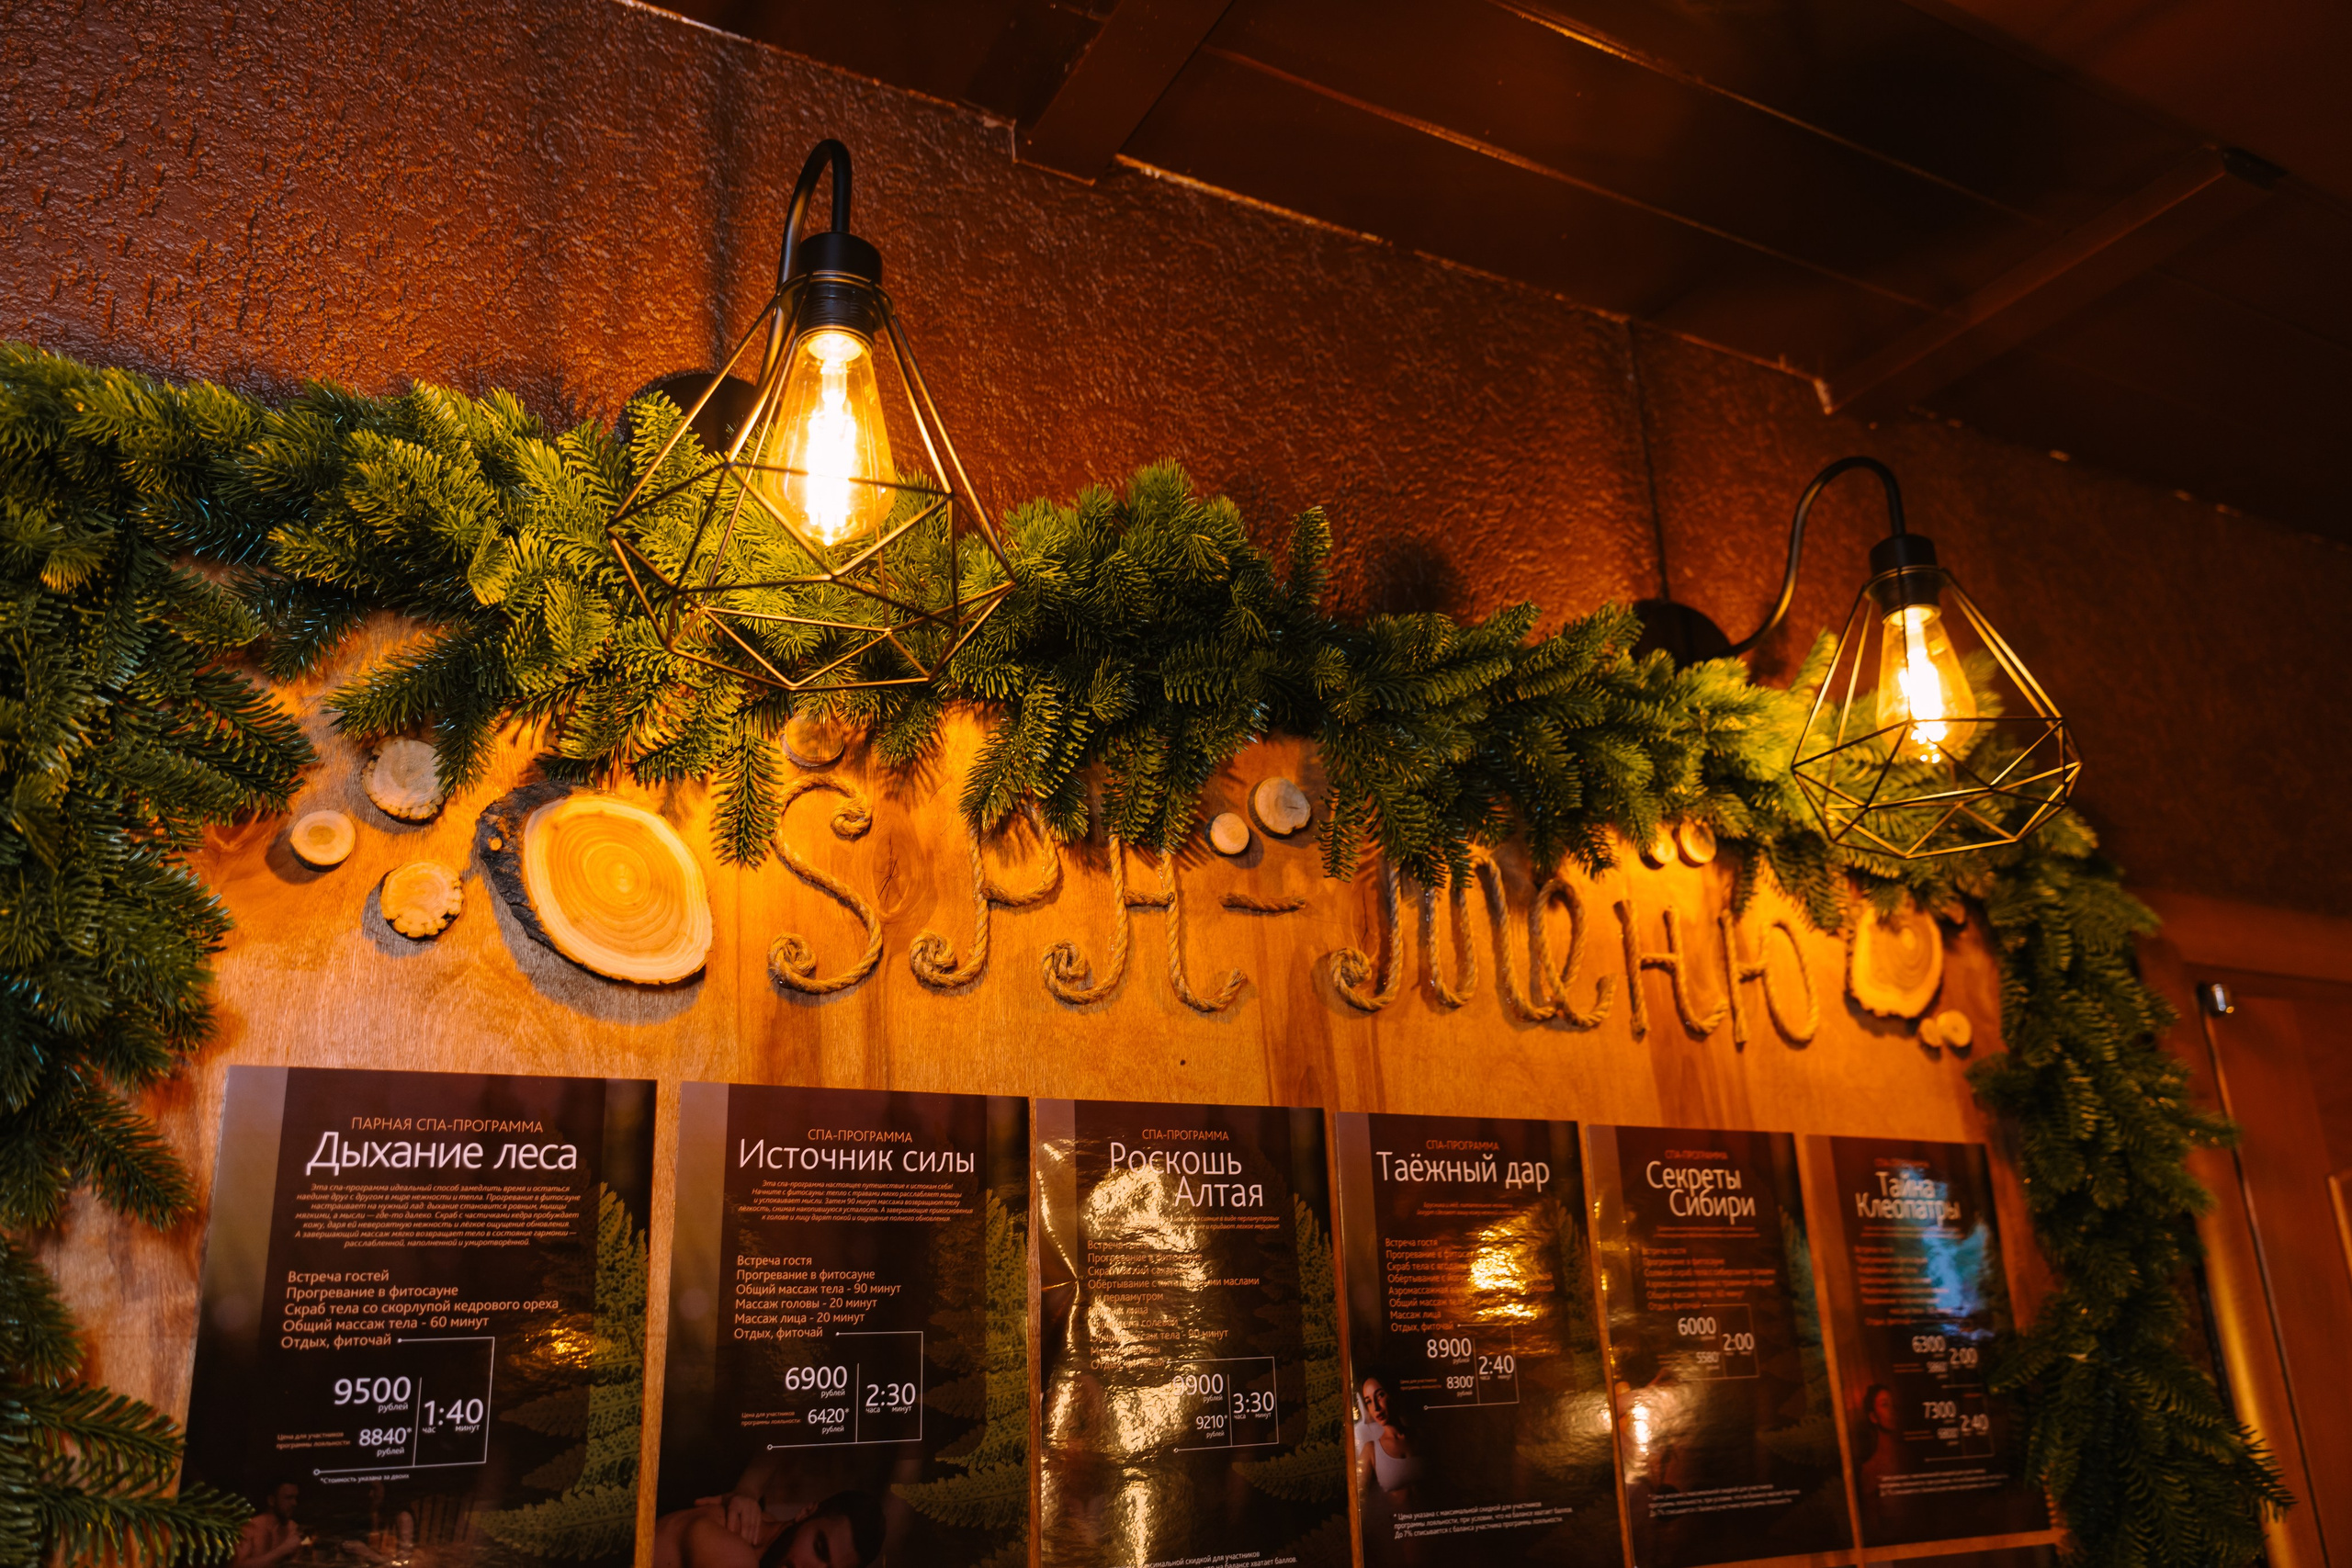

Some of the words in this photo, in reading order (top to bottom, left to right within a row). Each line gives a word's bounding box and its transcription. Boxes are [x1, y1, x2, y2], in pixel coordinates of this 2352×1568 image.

[352, 1117, 413, 1130] ПАРНАЯ
[416, 1118, 544, 1133] СПА-ПРОГРАММА
[808, 1128, 913, 1143] СПА-ПРОГРАММА
[1142, 1128, 1229, 1141] СПА-ПРОГРАММА
[1426, 1140, 1499, 1151] СПА-ПРОГРАММА
[306, 1131, 484, 1177] Дыхание
[492, 1143, 577, 1169] леса
[740, 1138, 894, 1171] Источник
[902, 1150, 975, 1173] силы
[1110, 1142, 1242, 1176] Роскошь
[1375, 1151, 1498, 1183] Таёжный
[1505, 1161, 1550, 1192] дар
[1645, 1160, 1742, 1197] Секреты
[1874, 1170, 1936, 1199] Тайна
[311, 1183, 328, 1191] Эта
[330, 1184, 389, 1193] спа-программа
[390, 1183, 432, 1191] идеальный
[503, 1185, 526, 1193] время
[1174, 1175, 1263, 1207] Алтая
[1669, 1185, 1757, 1225] Сибири
[1855, 1192, 1961, 1228] Клеопатры
[1087, 1240, 1122, 1252] Встреча
[1385, 1238, 1416, 1249] Встреча
[737, 1255, 781, 1268] Встреча
[783, 1256, 812, 1266] гостя
[1087, 1252, 1147, 1265] Прогревание
[1385, 1250, 1436, 1260] Прогревание
[1386, 1262, 1410, 1272] Скраб
[288, 1270, 342, 1285] Встреча
[345, 1269, 390, 1282] гостей
[736, 1269, 808, 1282] Прогревание
[810, 1271, 817, 1280] в
[819, 1269, 876, 1282] фитосауне
[1387, 1274, 1441, 1285] Обёртывание
[736, 1283, 775, 1296] Общий
[778, 1286, 818, 1295] массаж
[820, 1285, 844, 1294] тела
[854, 1283, 868, 1294] 90
[869, 1284, 901, 1296] минут
[1087, 1279, 1149, 1292] Обёртывание
[1223, 1277, 1260, 1286] маслами
[286, 1286, 375, 1302] Прогревание
[378, 1288, 386, 1298] в
[389, 1284, 458, 1300] фитосауне
[1102, 1292, 1164, 1304] перламутром
[285, 1303, 326, 1318] Скраб
[330, 1304, 359, 1314] тела
[363, 1304, 378, 1314] со
[381, 1300, 451, 1315] скорлупой
[454, 1301, 520, 1314] кедрового
[523, 1300, 559, 1313] ореха
[735, 1299, 778, 1310] Массаж
[781, 1298, 820, 1309] головы
[829, 1297, 843, 1309] 20
[845, 1298, 877, 1311] минут
[1389, 1297, 1418, 1308] Общий
[1126, 1306, 1148, 1316] лица
[1390, 1311, 1421, 1320] Массаж
[1422, 1311, 1442, 1320] лица
[283, 1318, 332, 1333] Общий
[335, 1320, 385, 1330] массаж
[389, 1319, 418, 1329] тела
[430, 1315, 447, 1327] 60
[450, 1317, 490, 1330] минут
[735, 1314, 778, 1325] Массаж
[780, 1314, 807, 1325] лица
[816, 1312, 831, 1323] 20
[832, 1313, 865, 1325] минут
[1140, 1317, 1179, 1328] солевой
[1391, 1323, 1419, 1333] Отдых,
[1420, 1321, 1453, 1332] фиточай
[1678, 1316, 1717, 1336] 6000
[734, 1328, 774, 1340] Отдых,
[775, 1326, 823, 1341] фиточай
[1160, 1331, 1181, 1340] тела
[1202, 1328, 1228, 1341] минут
[281, 1336, 330, 1349] Отдых,
[334, 1333, 391, 1350] фиточай
[1427, 1337, 1472, 1359] 8900
[1723, 1333, 1755, 1351] 2:00
[1478, 1355, 1515, 1375] 2:40
[785, 1365, 848, 1391] 6900
[1172, 1373, 1224, 1396] 9900
[334, 1376, 412, 1405] 9500
[820, 1389, 845, 1399] рублей
[865, 1382, 916, 1407] 2:30
[1203, 1394, 1223, 1404] рублей
[1233, 1391, 1274, 1414] 3:30
[378, 1403, 409, 1414] рублей
[424, 1398, 484, 1426] 1:40
[891, 1405, 911, 1414] минут
[1922, 1400, 1957, 1419] 7300
[308, 1431, 345, 1440] участников
[455, 1425, 481, 1434] минут
[821, 1426, 845, 1435] рублей
[1206, 1430, 1225, 1438] рублей
[276, 1442, 312, 1450] программы
[377, 1447, 405, 1458] рублей
[358, 1474, 382, 1483] указана
[390, 1472, 410, 1481] двоих
[1184, 1555, 1212, 1565] скидкой
[1212, 1554, 1224, 1562] для
[1225, 1551, 1261, 1562] участников
